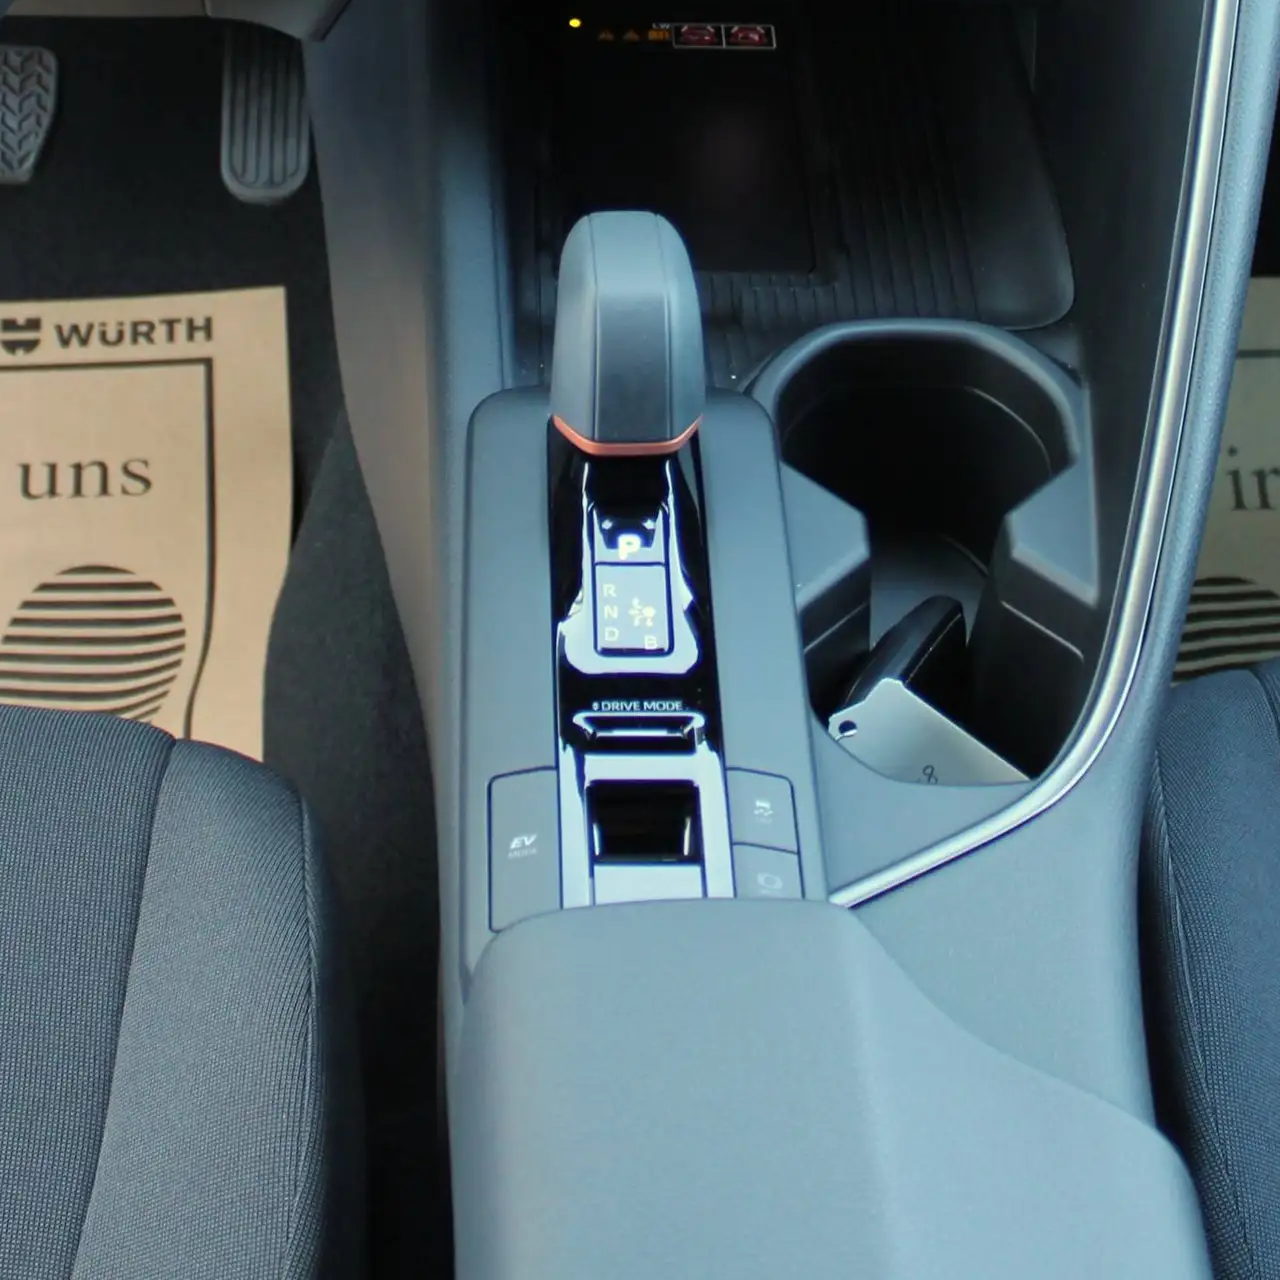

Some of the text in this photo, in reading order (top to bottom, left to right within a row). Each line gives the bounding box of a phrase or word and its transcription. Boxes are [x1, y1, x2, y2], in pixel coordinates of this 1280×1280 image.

[17, 456, 154, 501] uns
[617, 533, 642, 561] P
[603, 584, 617, 598] R
[604, 604, 618, 619] N
[605, 627, 620, 642] D
[644, 635, 658, 650] B
[601, 700, 683, 711] DRIVE MODE
[510, 834, 537, 849] EV
